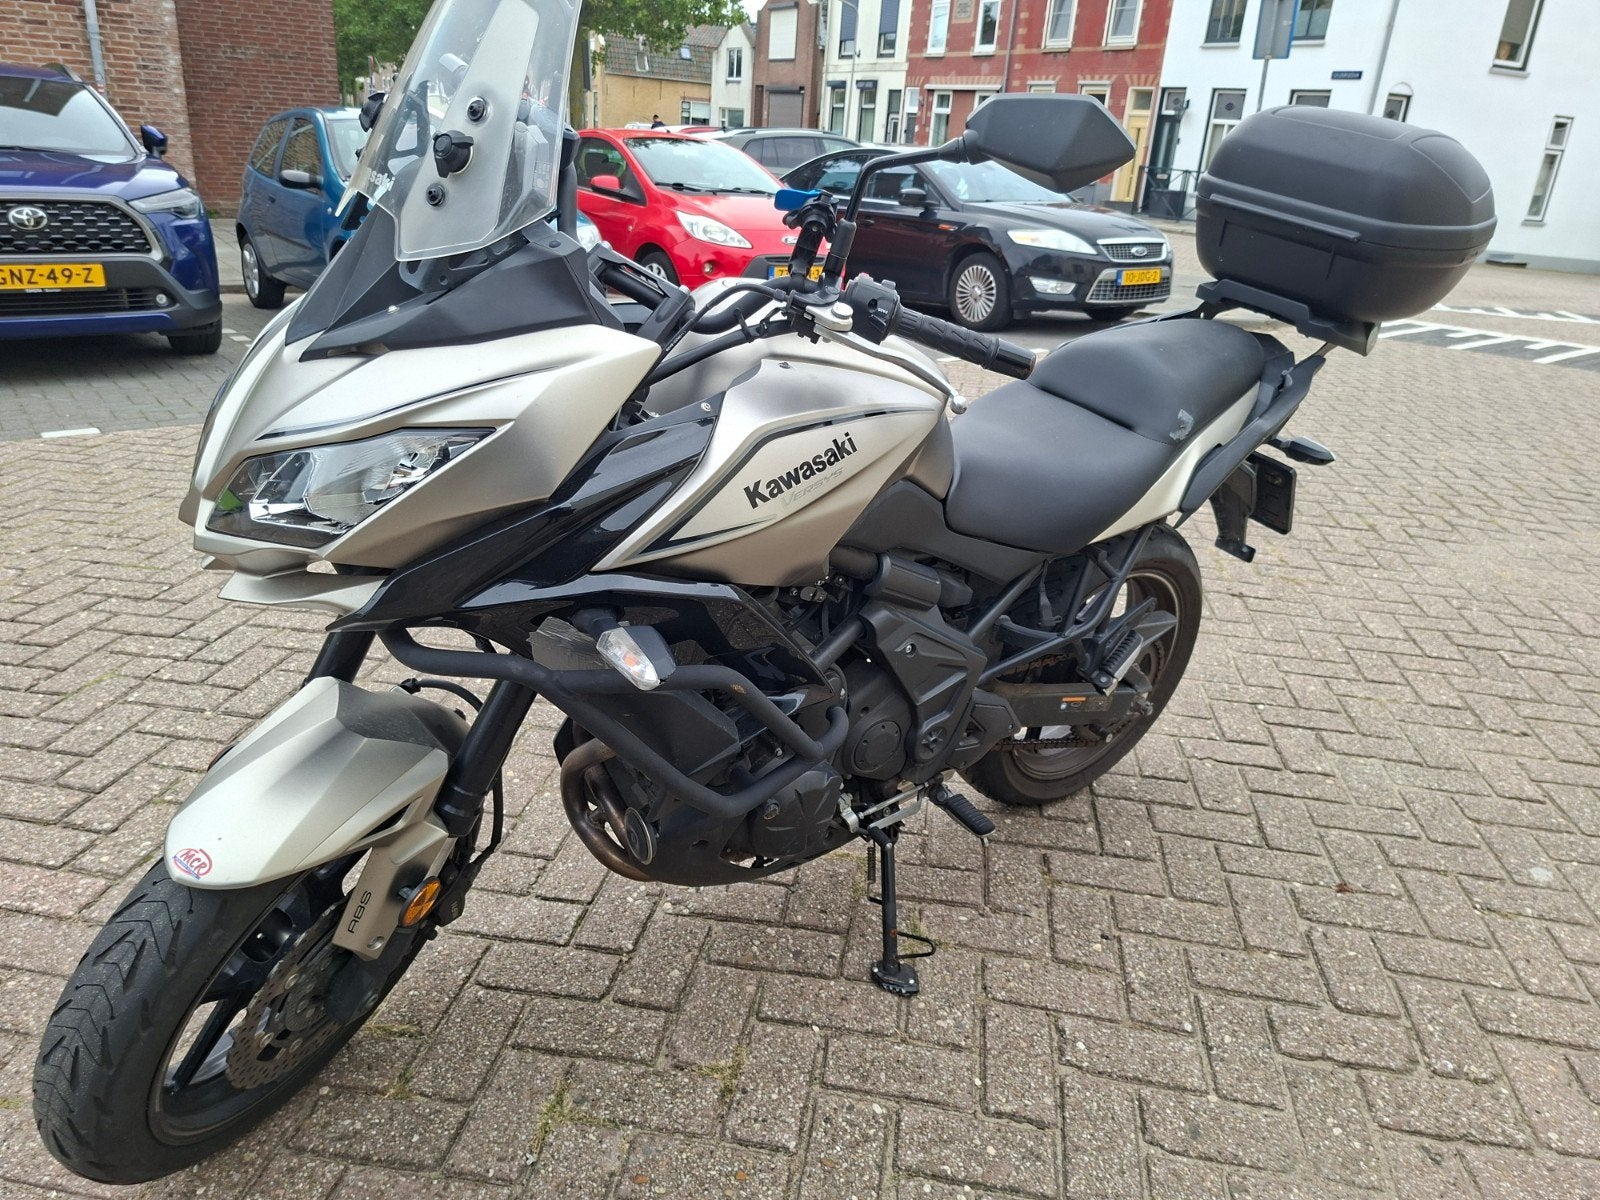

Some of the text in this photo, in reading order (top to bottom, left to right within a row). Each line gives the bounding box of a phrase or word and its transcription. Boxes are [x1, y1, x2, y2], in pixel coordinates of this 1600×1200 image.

[0, 268, 95, 285] GNZ-49-Z
[743, 432, 858, 509] Kawasaki
[180, 850, 207, 875] MCR
[347, 890, 371, 934] ABS
